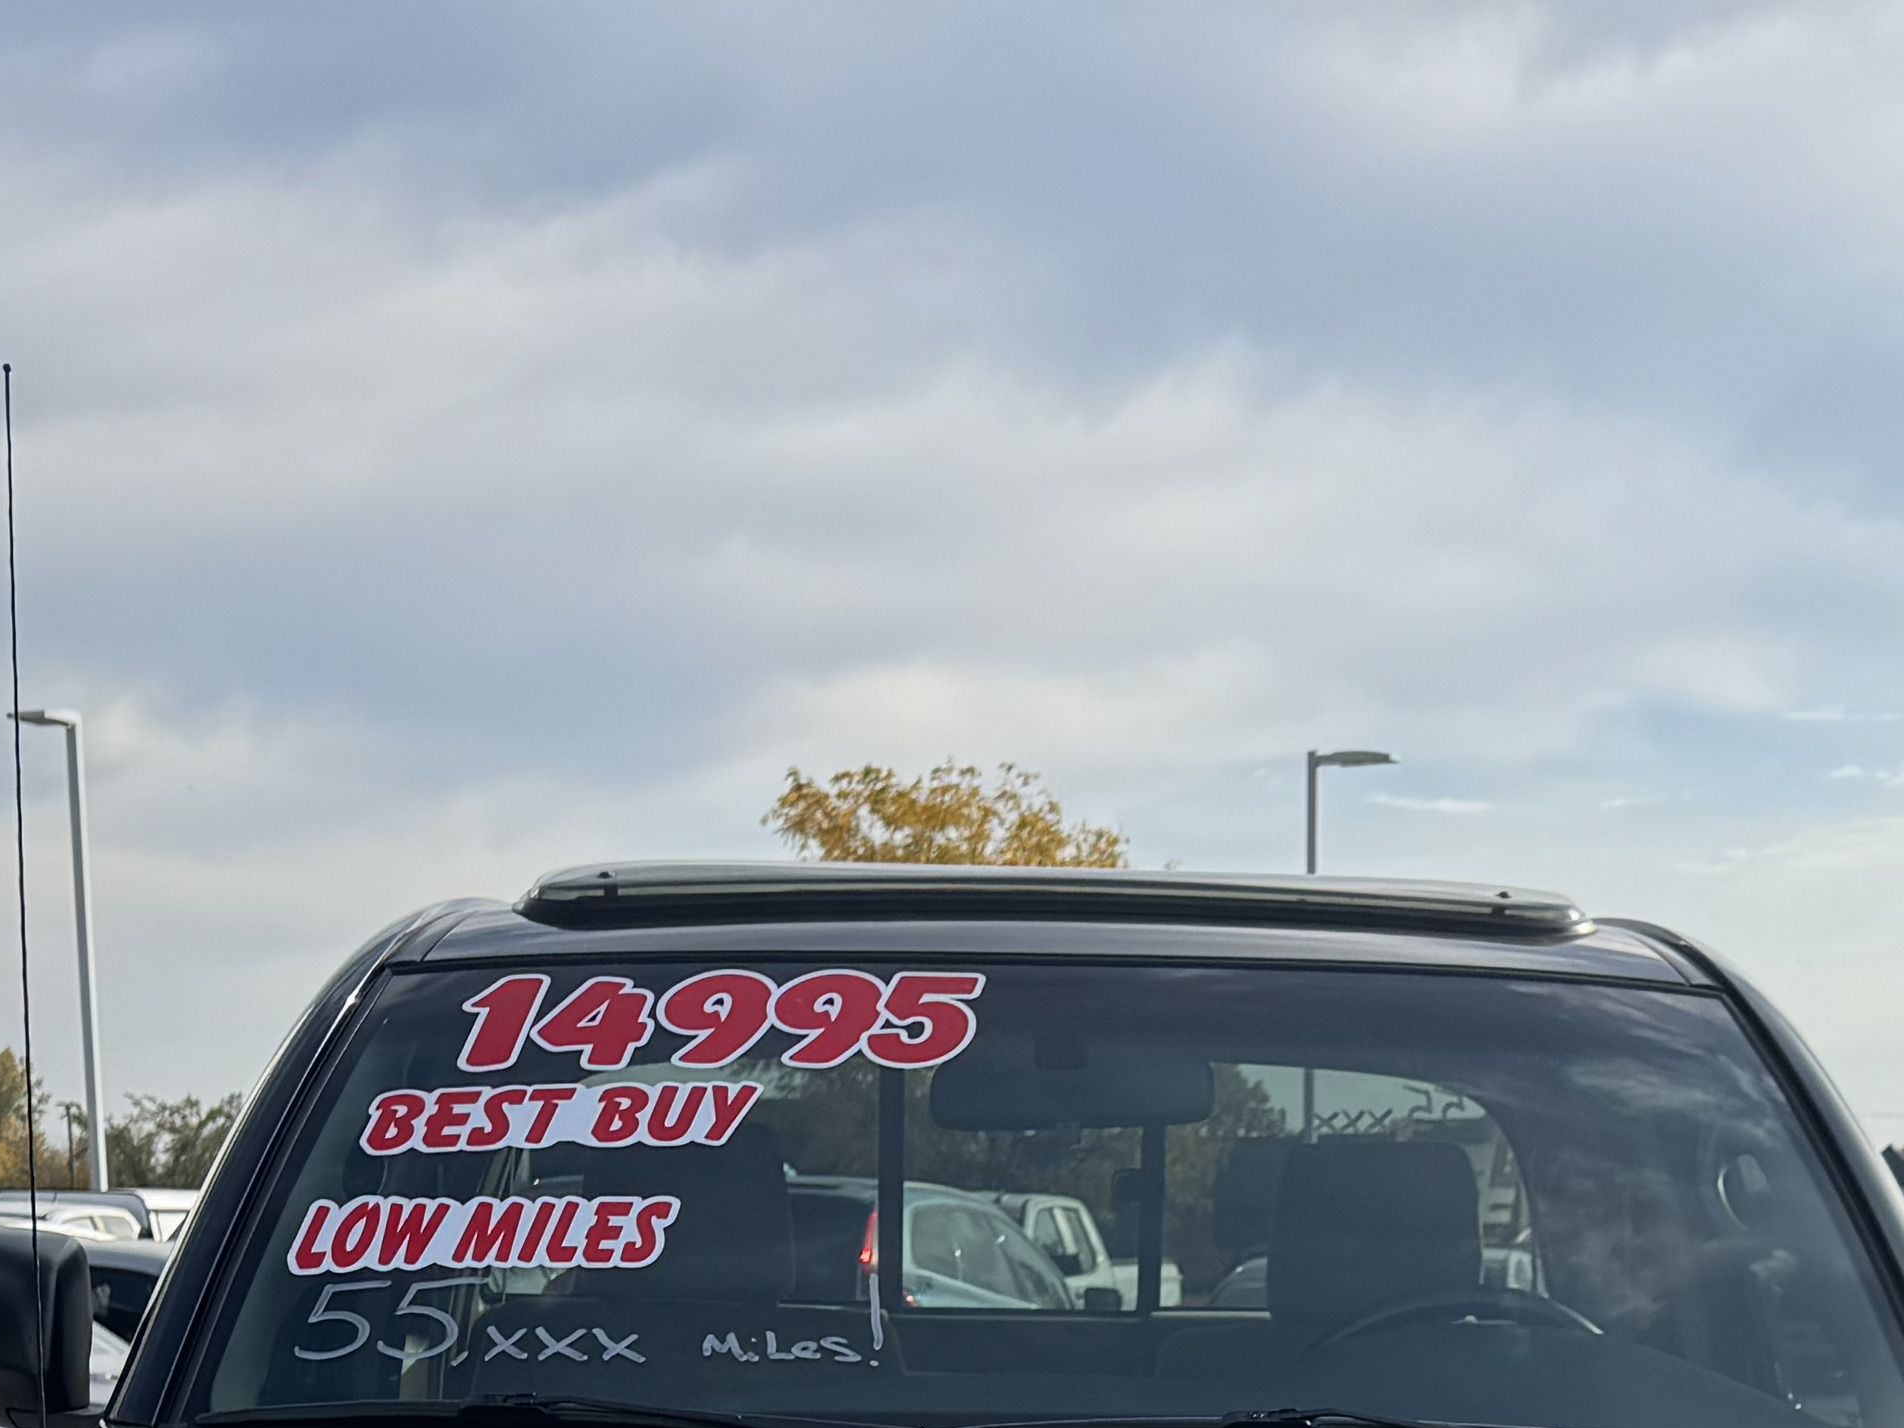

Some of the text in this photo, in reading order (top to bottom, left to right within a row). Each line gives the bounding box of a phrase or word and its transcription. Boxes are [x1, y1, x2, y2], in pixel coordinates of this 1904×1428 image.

[459, 969, 985, 1071] 14995
[363, 1082, 760, 1153] BEST BUY
[290, 1198, 677, 1271] LOW MILES
